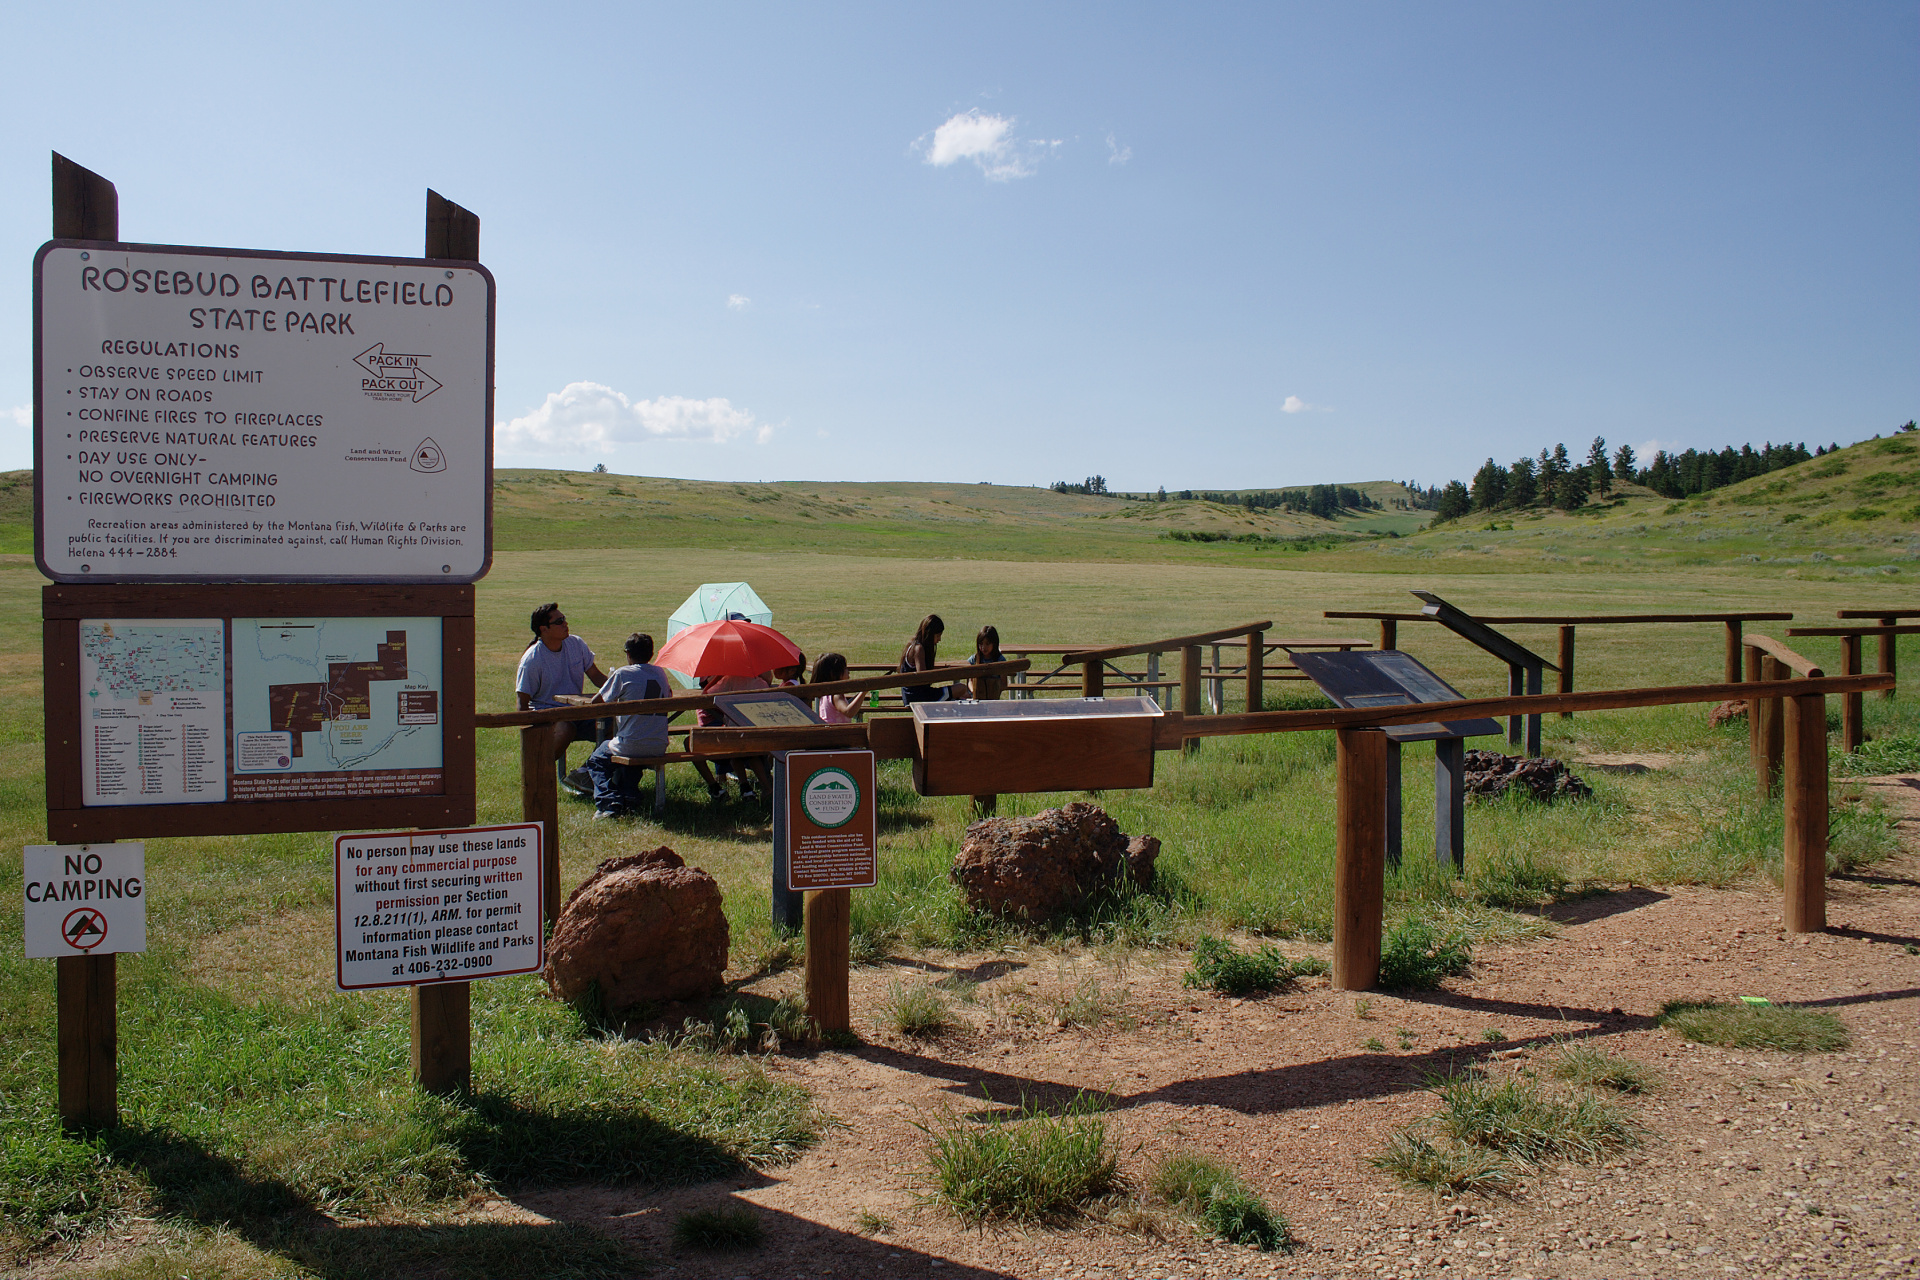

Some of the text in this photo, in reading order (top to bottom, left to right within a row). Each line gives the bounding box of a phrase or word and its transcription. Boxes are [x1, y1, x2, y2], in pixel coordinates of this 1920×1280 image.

[81, 266, 453, 306] ROSEBUD BATTLEFIELD
[189, 307, 354, 335] STATE PARK
[101, 339, 239, 358] REGULATIONS
[369, 355, 418, 367] PACK IN
[79, 364, 263, 383] OBSERVE SPEED LIMIT
[362, 378, 424, 390] PACK OUT
[78, 386, 212, 402] STAY ON ROADS
[78, 408, 323, 426] CONFINE FIRES TO FIREPLACES
[79, 429, 317, 447] PRESERVE NATURAL FEATURES
[78, 450, 110, 464] DAY
[116, 451, 147, 464] USE
[79, 469, 277, 486] NO OVERNIGHT CAMPING
[79, 492, 275, 508] FIREWORKS PROHIBITED
[87, 518, 146, 529] Recreation
[182, 520, 248, 530] administered
[252, 520, 263, 532] by
[267, 520, 284, 530] the
[288, 520, 331, 530] Montana
[335, 520, 357, 531] Fish,
[359, 521, 403, 531] Wildlife
[407, 521, 416, 531] &
[419, 521, 447, 532] Parks
[68, 532, 101, 545] public
[104, 532, 156, 544] facilities.
[159, 533, 169, 544] If
[172, 536, 189, 545] you
[214, 534, 283, 544] discriminated
[287, 534, 326, 548] against,
[329, 534, 347, 544] call
[351, 534, 383, 545] Human
[387, 534, 417, 549] Rights
[68, 546, 104, 557] Helena
[347, 836, 526, 860] No person may use these lands
[65, 854, 102, 875] NO
[355, 855, 516, 877] for any commercial purpose
[26, 878, 142, 902] CAMPING
[354, 871, 522, 893] without first securing written
[375, 888, 507, 912] permission per Section
[354, 902, 521, 927] 12.8.211(1), ARM. for permit
[362, 919, 518, 944] information please contact
[345, 934, 533, 962] Montana Fish Wildlife and Parks
[391, 954, 492, 975] at 406-232-0900
